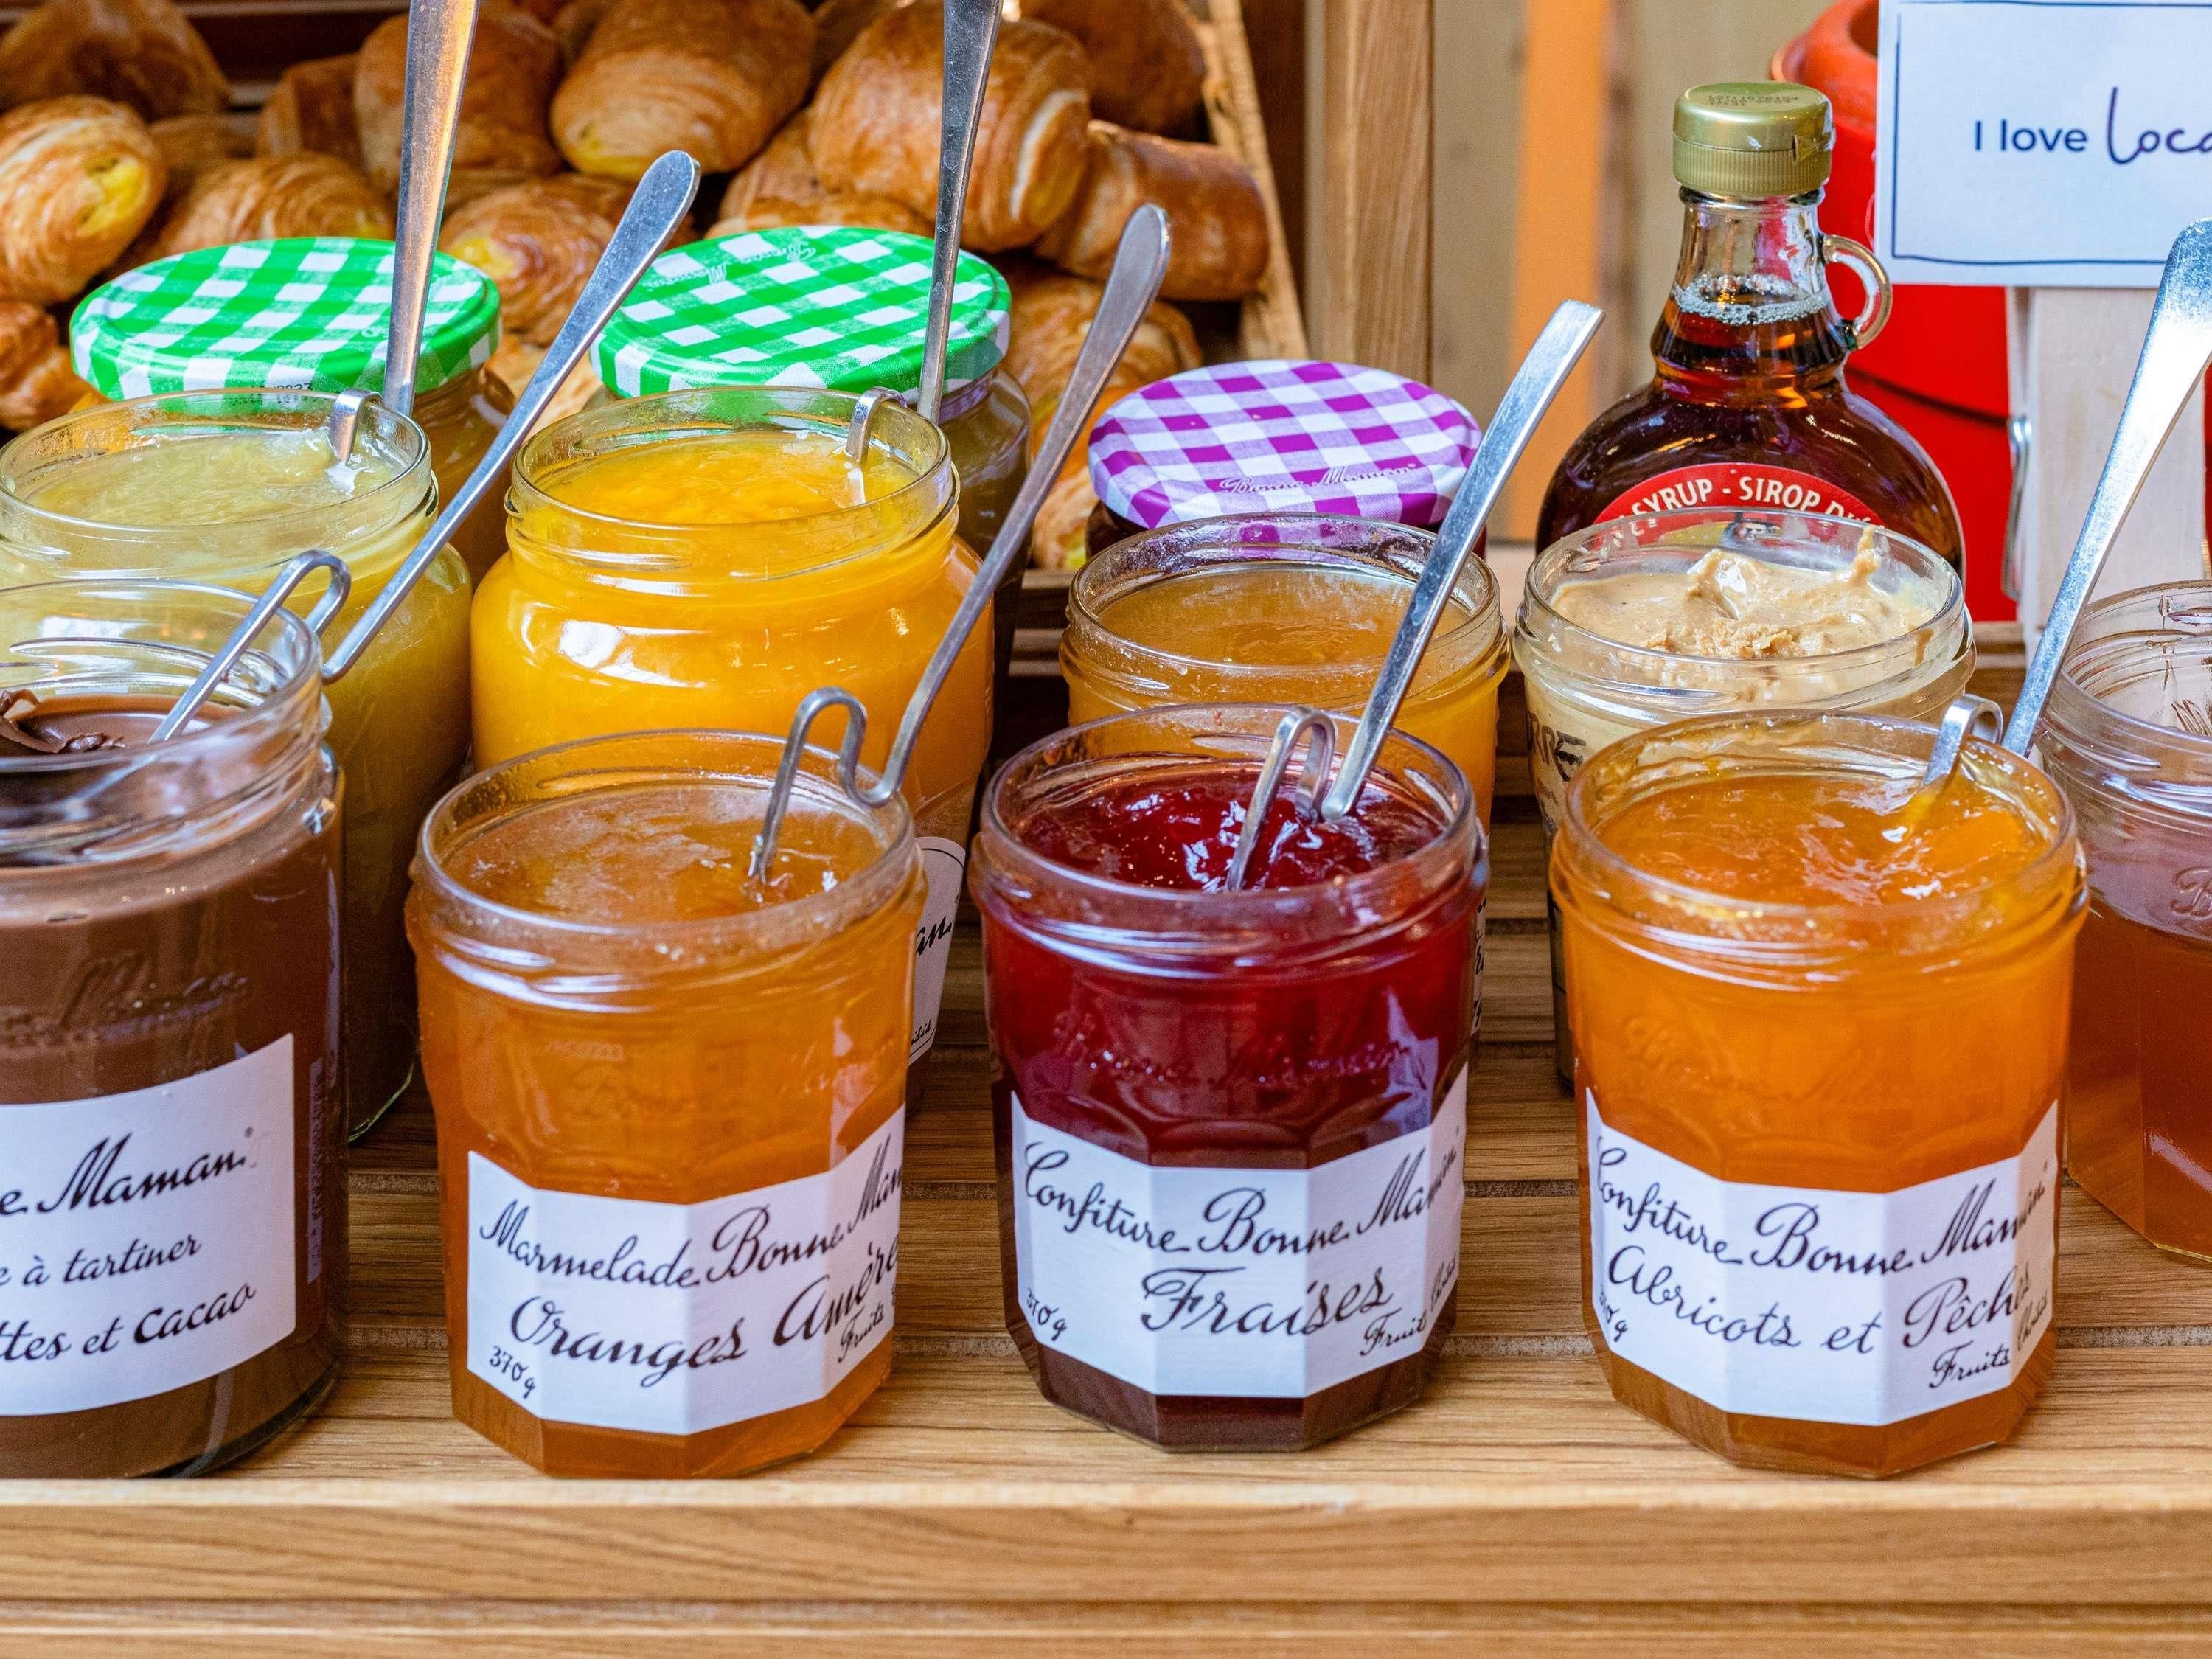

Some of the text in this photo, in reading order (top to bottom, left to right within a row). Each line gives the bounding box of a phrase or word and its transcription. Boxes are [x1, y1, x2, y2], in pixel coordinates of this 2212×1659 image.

[1974, 120, 1982, 150] I
[2000, 119, 2088, 151] love
[1632, 478, 1713, 515] SYRUP
[1739, 476, 1821, 512] SIROP
[37, 1132, 246, 1213] Maman
[1024, 1141, 1190, 1252] Confiture
[1197, 1187, 1349, 1255] Bonne
[1596, 1135, 1742, 1265] Confiture
[1750, 1203, 1913, 1277] Bonne
[22, 1254, 50, 1286] à
[63, 1234, 201, 1284] tartiner
[479, 1199, 700, 1288] Marmelade
[706, 1203, 843, 1284] Bonne
[82, 1317, 124, 1355] et
[133, 1283, 257, 1344] Cacao
[1141, 1266, 1394, 1335] Fraises
[1608, 1245, 1801, 1348] Abricots
[1820, 1310, 1884, 1354] et
[510, 1295, 747, 1388] Oranges
[1930, 1339, 2011, 1388] Fruits
